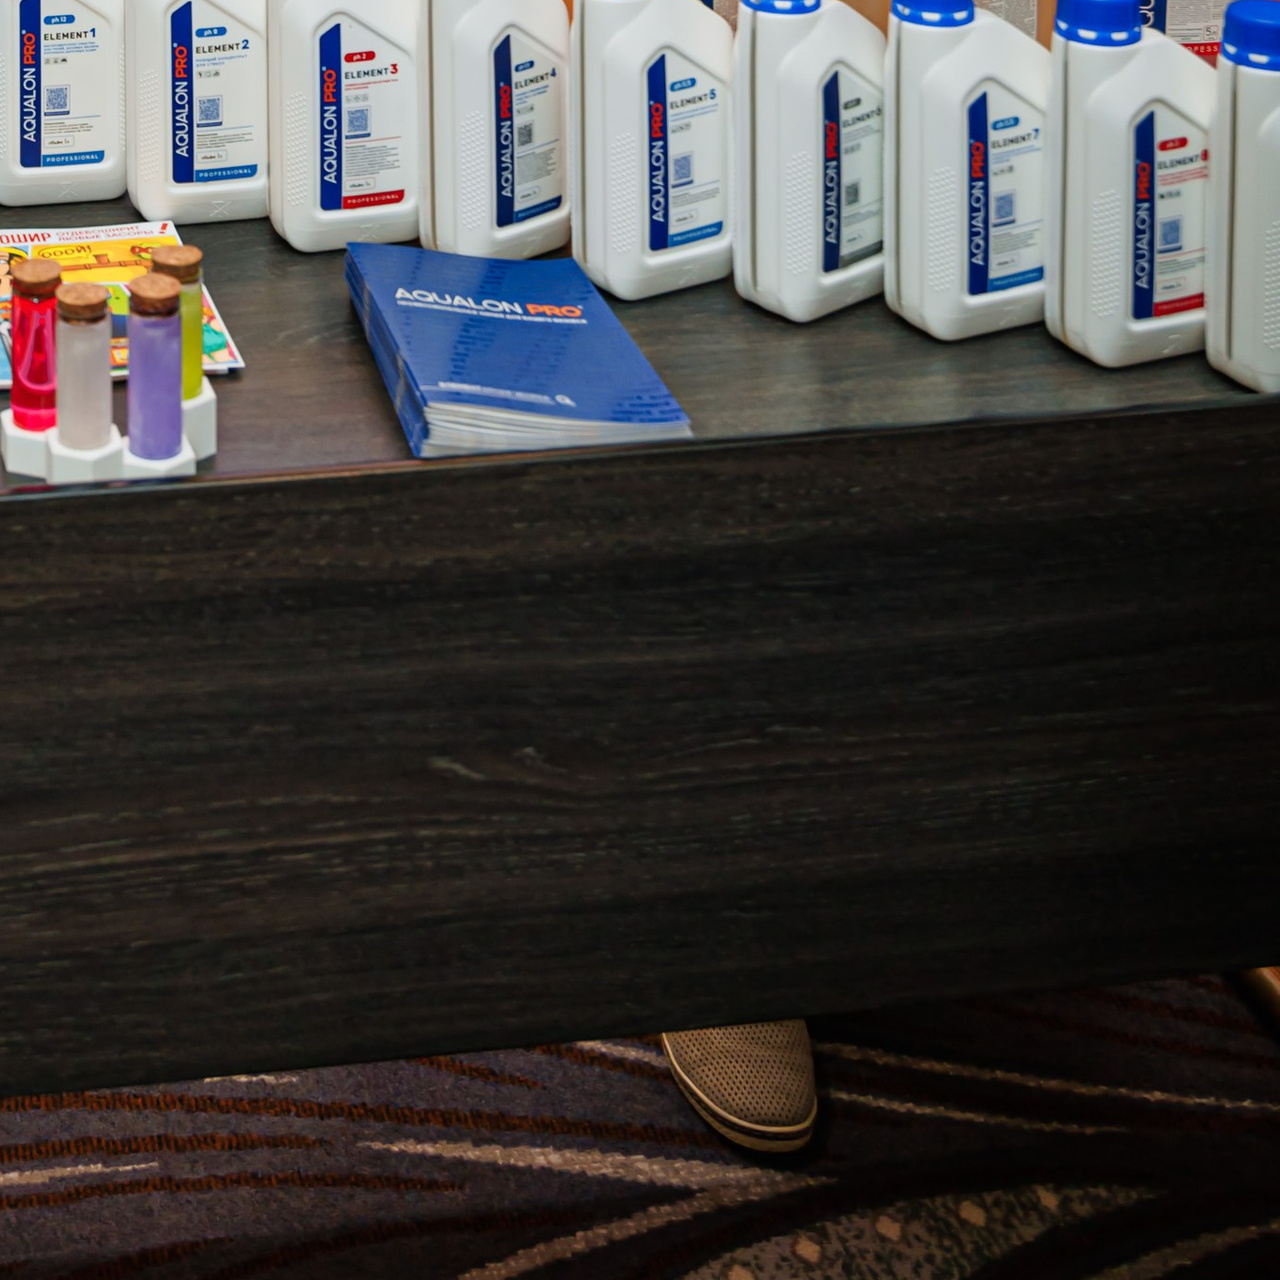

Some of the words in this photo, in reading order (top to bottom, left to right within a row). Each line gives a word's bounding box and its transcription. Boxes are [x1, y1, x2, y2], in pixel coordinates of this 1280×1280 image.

[23, 32, 36, 65] PRO
[43, 31, 89, 41] ELEMENT
[89, 27, 97, 38] 1
[195, 44, 241, 54] ELEMENT
[241, 39, 250, 50] 2
[175, 45, 188, 78] PRO
[345, 67, 389, 80] ELEMENT
[390, 63, 398, 74] 3
[323, 69, 336, 102] PRO
[514, 73, 549, 90] ELEMENT
[23, 67, 36, 142] AQUALON
[500, 85, 511, 118] PRO
[175, 81, 189, 157] AQUALON
[651, 103, 664, 139] PRO
[46, 154, 99, 163] PROFESSIONAL
[323, 106, 337, 184] AQUALON
[500, 121, 512, 197] AQUALON
[971, 142, 985, 178] PRO
[199, 169, 252, 178] PROFESSIONAL
[651, 141, 666, 223] AQUALON
[970, 180, 985, 266] AQUALON
[1135, 203, 1150, 289] AQUALON
[394, 287, 524, 315] AQUALON
[525, 303, 583, 318] PRO
